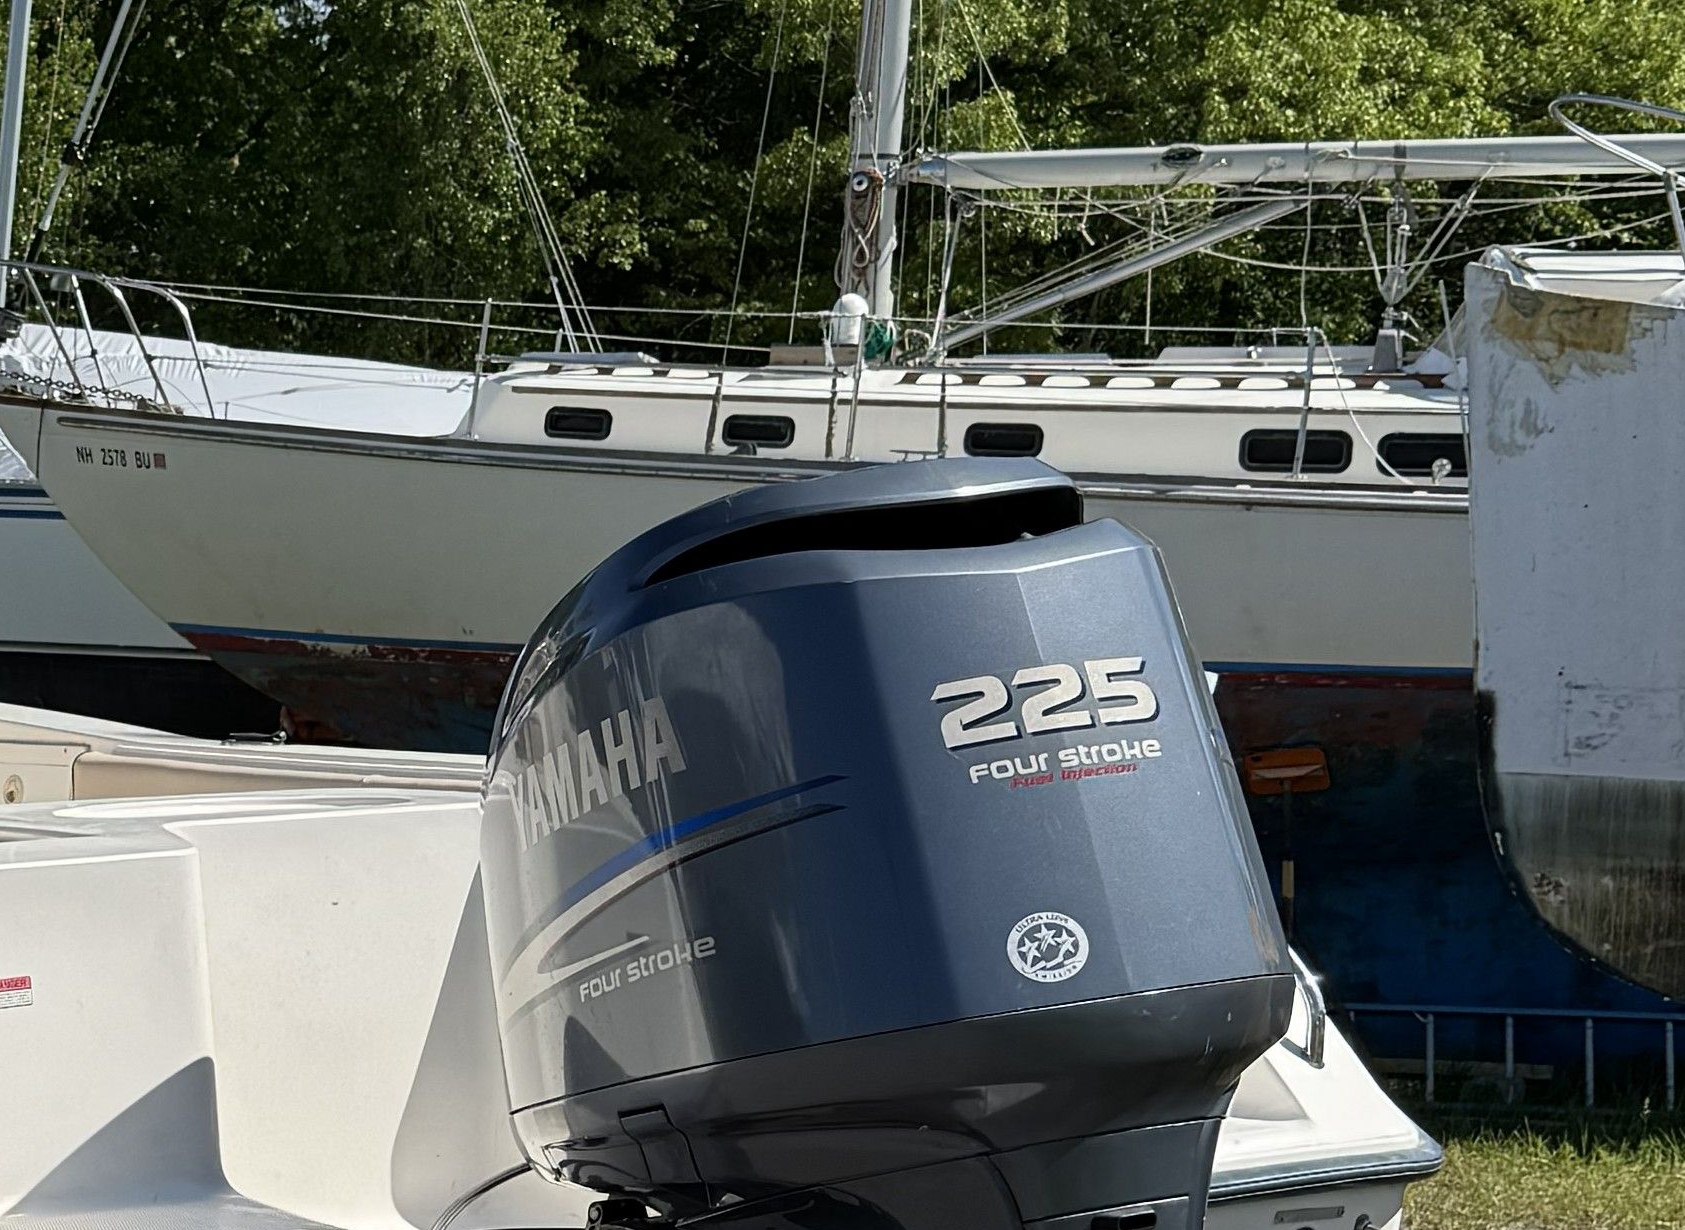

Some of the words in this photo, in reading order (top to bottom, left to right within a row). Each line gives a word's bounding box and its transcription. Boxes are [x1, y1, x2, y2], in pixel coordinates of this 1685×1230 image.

[76, 446, 93, 464] NH
[101, 448, 127, 467] 2578
[135, 451, 151, 469] BU
[930, 656, 1160, 749] 225
[509, 696, 688, 854] YAMAHA
